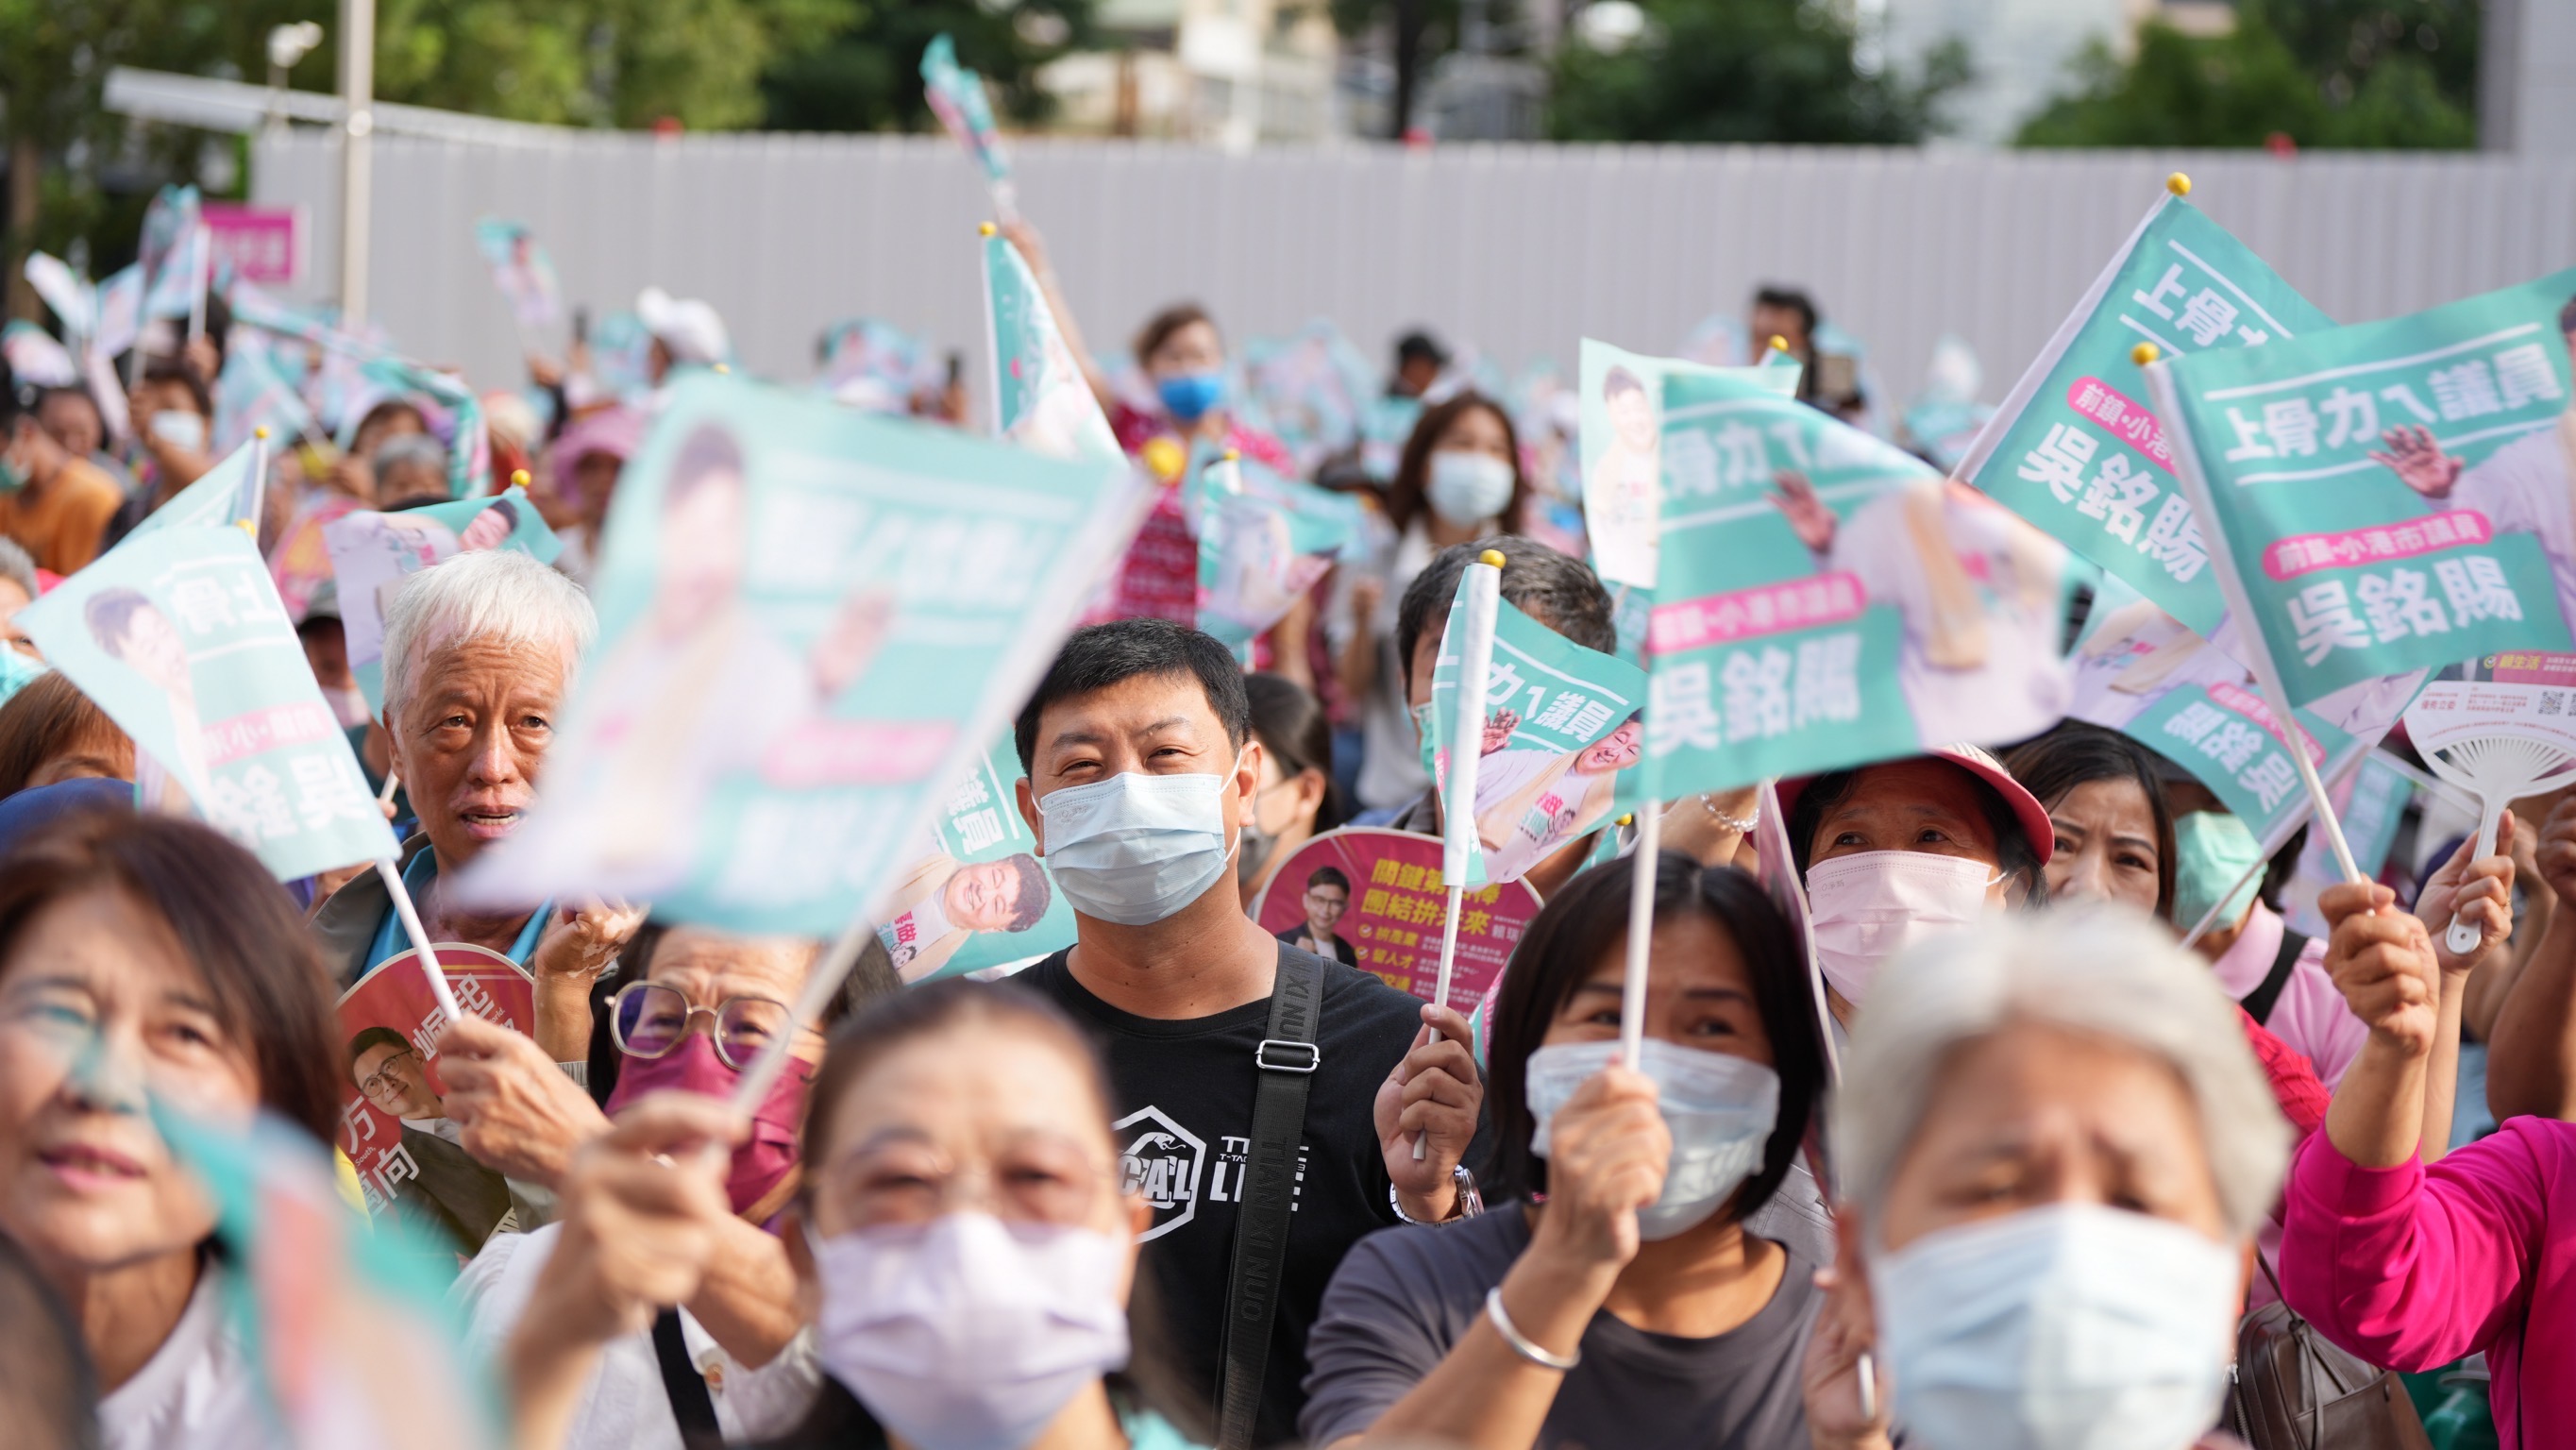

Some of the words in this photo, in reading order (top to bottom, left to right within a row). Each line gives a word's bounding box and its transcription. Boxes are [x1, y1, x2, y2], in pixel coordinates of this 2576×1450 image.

[2017, 422, 2209, 583] 吳銘賜
[2285, 555, 2524, 666] 吳銘賜
